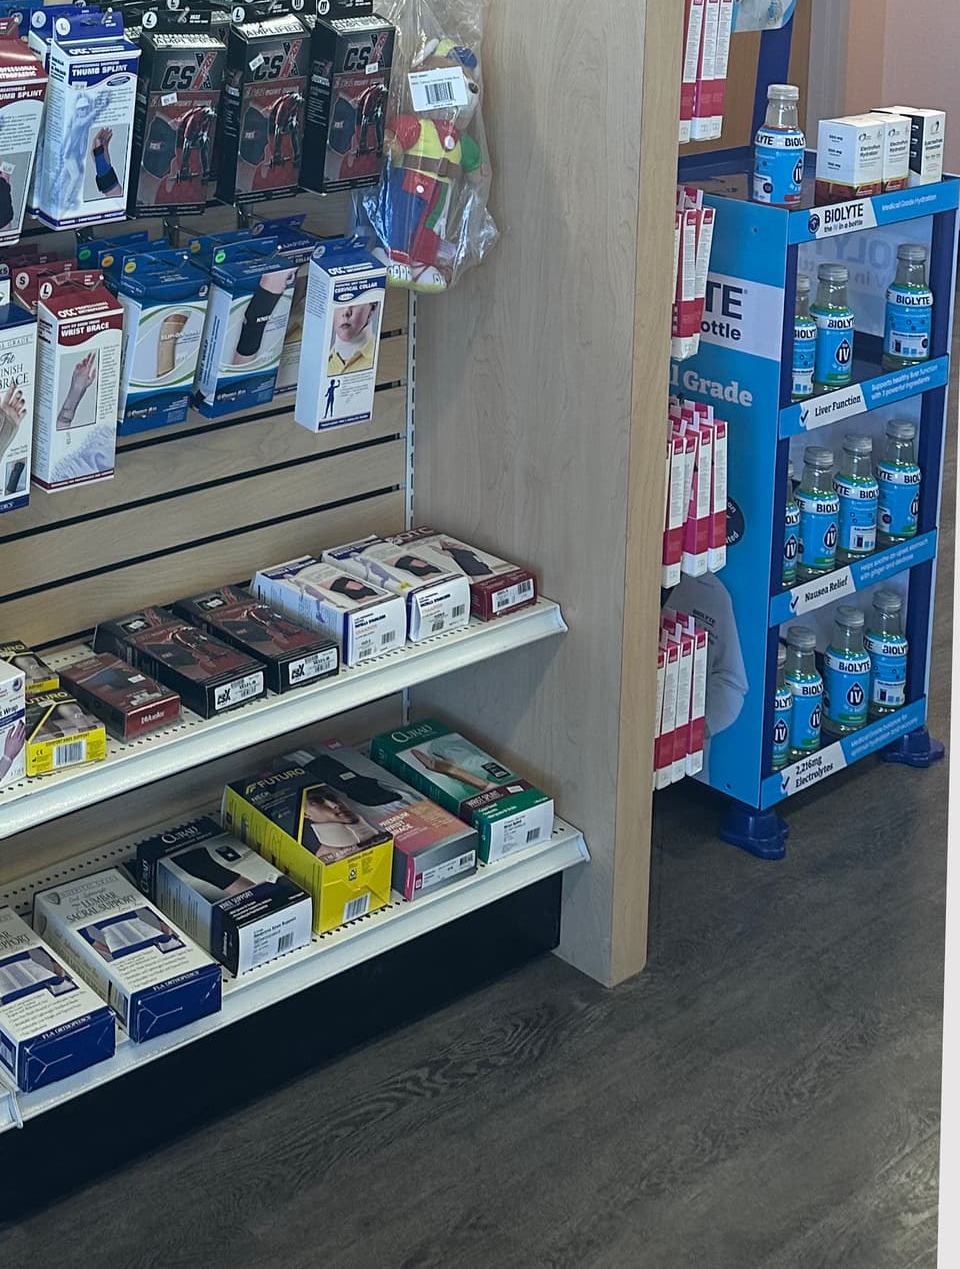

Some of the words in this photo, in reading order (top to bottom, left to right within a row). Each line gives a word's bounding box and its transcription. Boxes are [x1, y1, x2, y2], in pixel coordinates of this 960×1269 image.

[72, 67, 100, 76] THUMB
[102, 65, 128, 73] SPLINT
[18, 90, 43, 98] SPLINT
[882, 201, 901, 211] Medical
[901, 198, 915, 208] Grade
[916, 194, 936, 206] Hydration
[825, 203, 863, 224] BIOLYTE
[824, 225, 832, 233] the
[848, 220, 863, 228] bottle
[896, 295, 930, 305] BIOLYTE
[61, 326, 85, 338] WRIST
[86, 322, 110, 332] BRACE
[683, 372, 752, 408] Grade
[815, 405, 831, 417] Liver
[833, 395, 861, 411] Function
[805, 583, 828, 602] Nausea
[829, 575, 849, 591] Relief
[839, 661, 870, 671] BIOLYTE
[4, 704, 19, 716] Wrap
[796, 755, 823, 774] 2,216mg
[258, 768, 305, 789] FUTURO
[796, 762, 834, 788] Electrolytes
[67, 906, 100, 923] SACRAL
[100, 895, 137, 915] SUPPORT
[82, 892, 116, 909] LUMBAR
